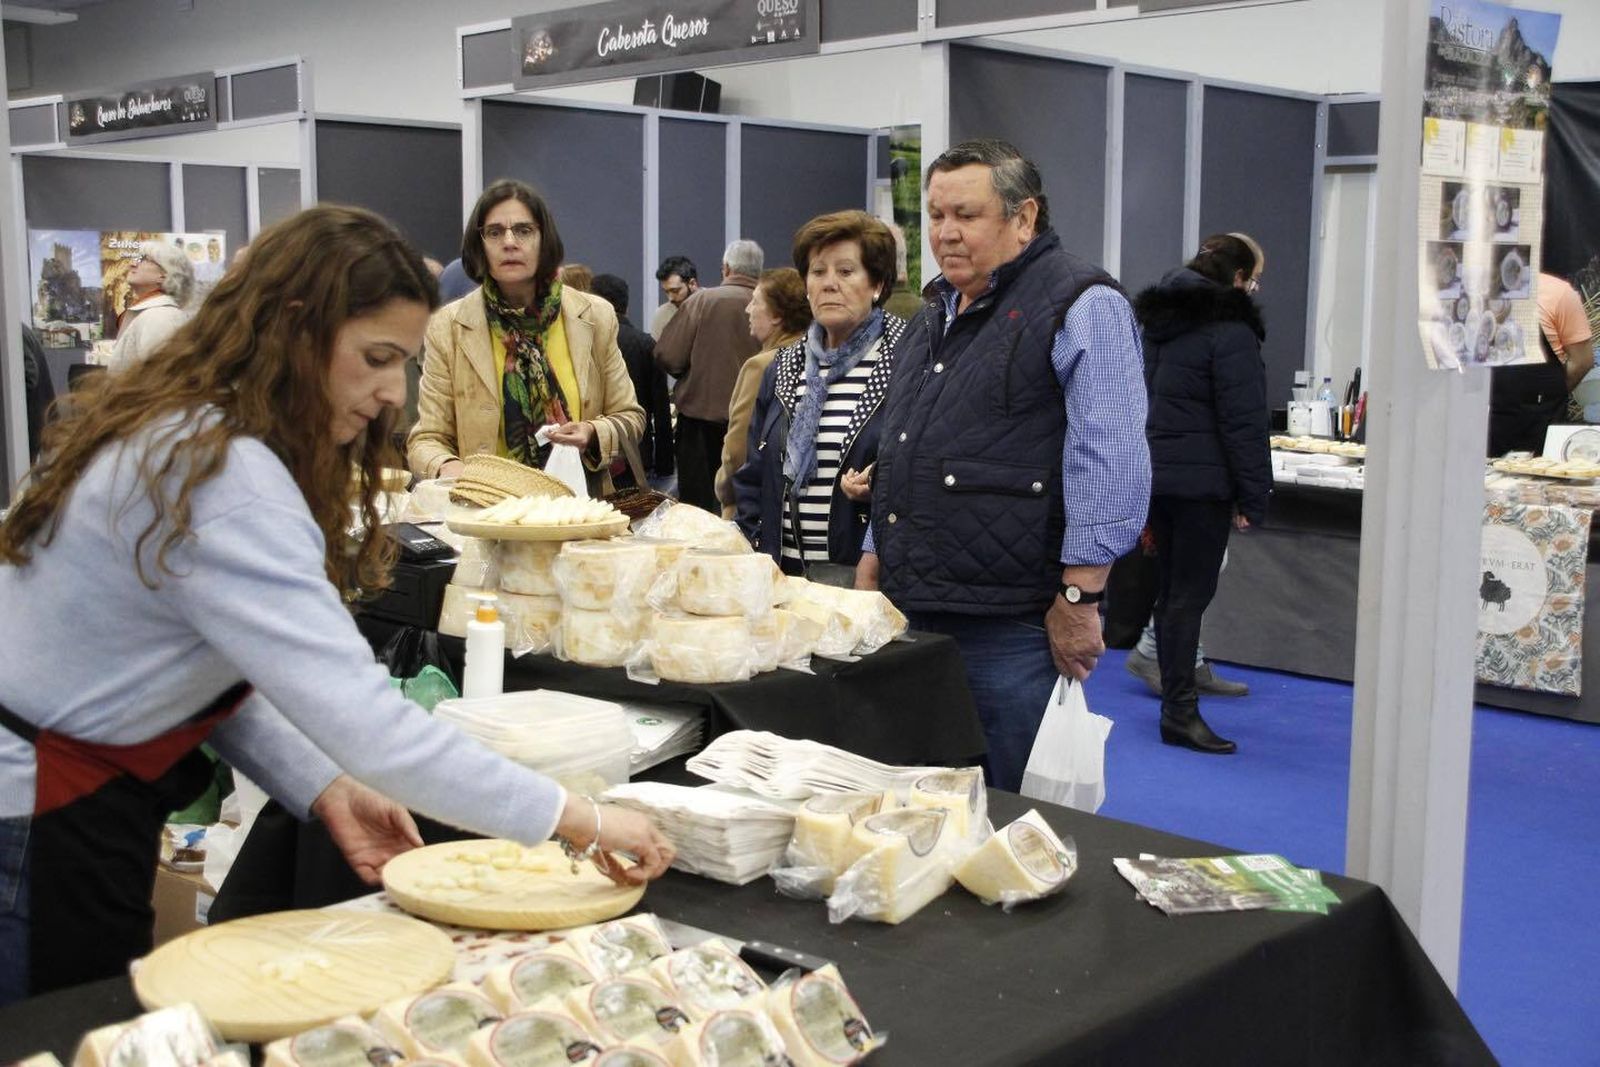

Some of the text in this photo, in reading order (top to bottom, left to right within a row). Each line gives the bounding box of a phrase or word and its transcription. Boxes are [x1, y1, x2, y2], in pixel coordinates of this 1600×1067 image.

[757, 0, 799, 17] QUESO
[598, 19, 658, 57] Cabesota
[662, 14, 710, 48] Quesos
